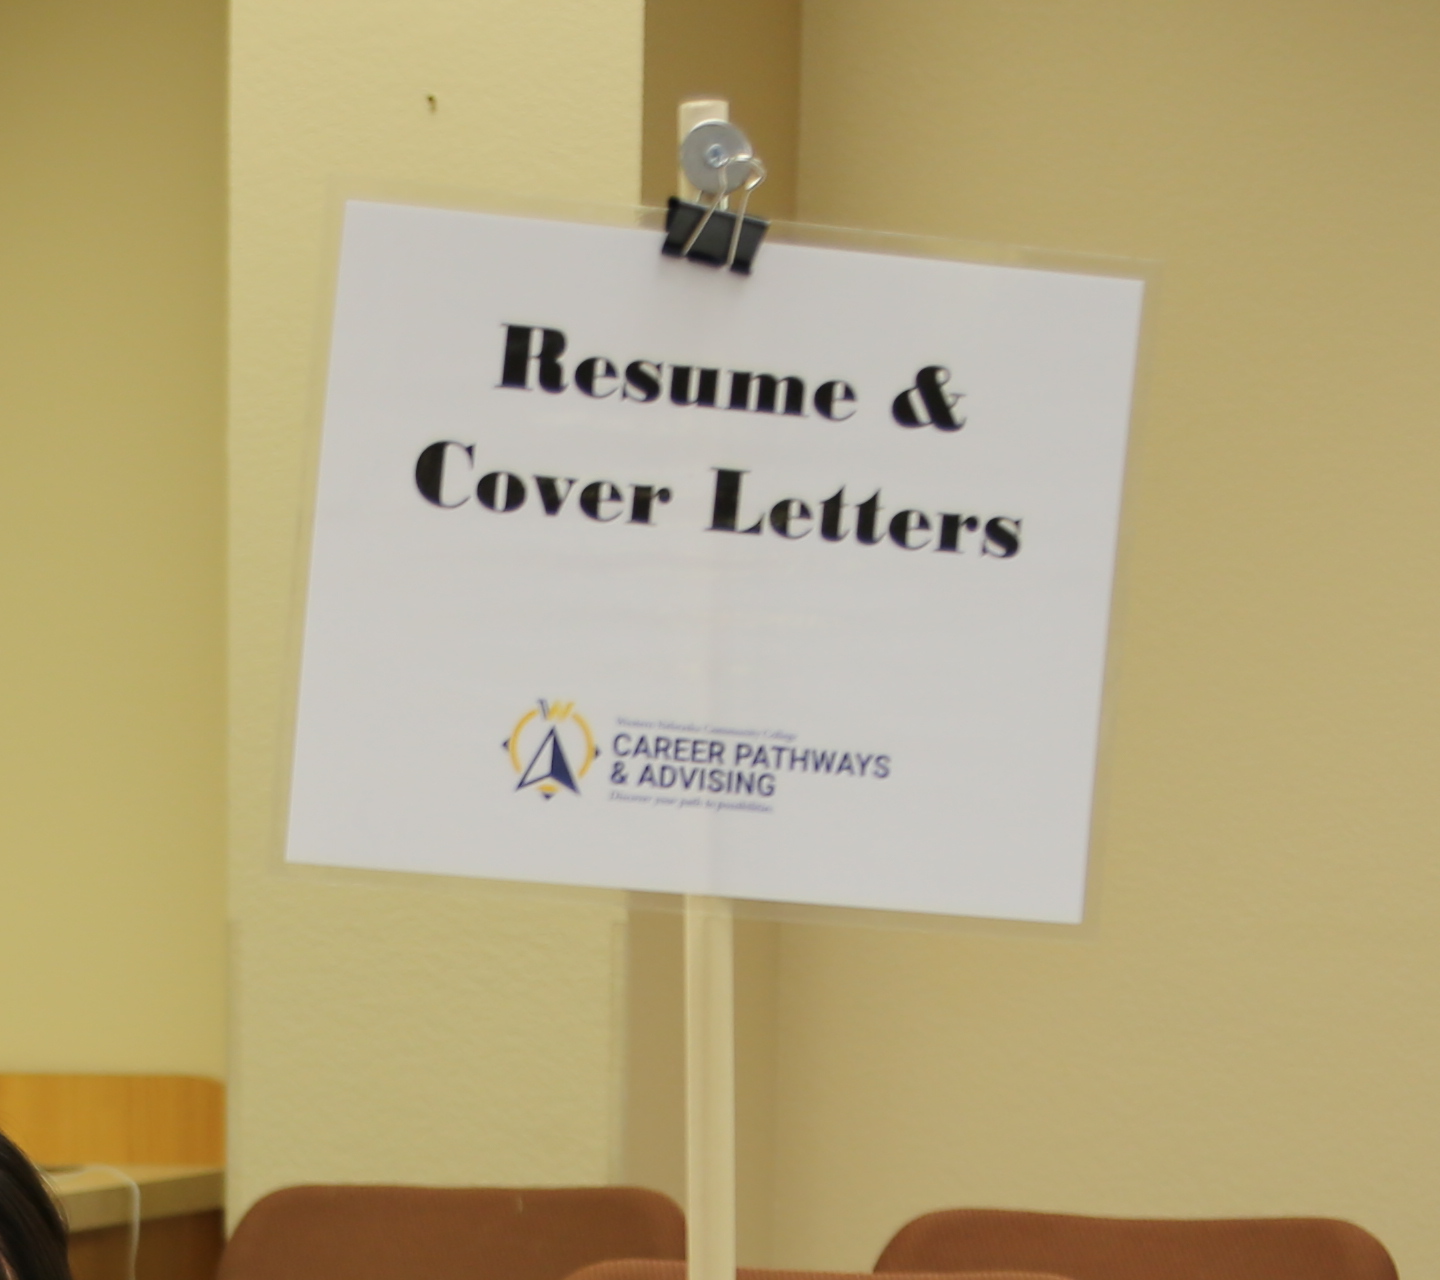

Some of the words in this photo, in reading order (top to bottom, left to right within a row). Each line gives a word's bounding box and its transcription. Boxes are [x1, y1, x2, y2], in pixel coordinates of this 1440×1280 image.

[493, 322, 858, 423] Resume
[890, 364, 968, 432] &
[414, 440, 672, 528] Cover
[704, 467, 1024, 561] Letters
[610, 761, 628, 786] &
[637, 764, 777, 797] ADVISING
[611, 733, 726, 766] CAREER
[733, 744, 892, 779] PATHWAYS
